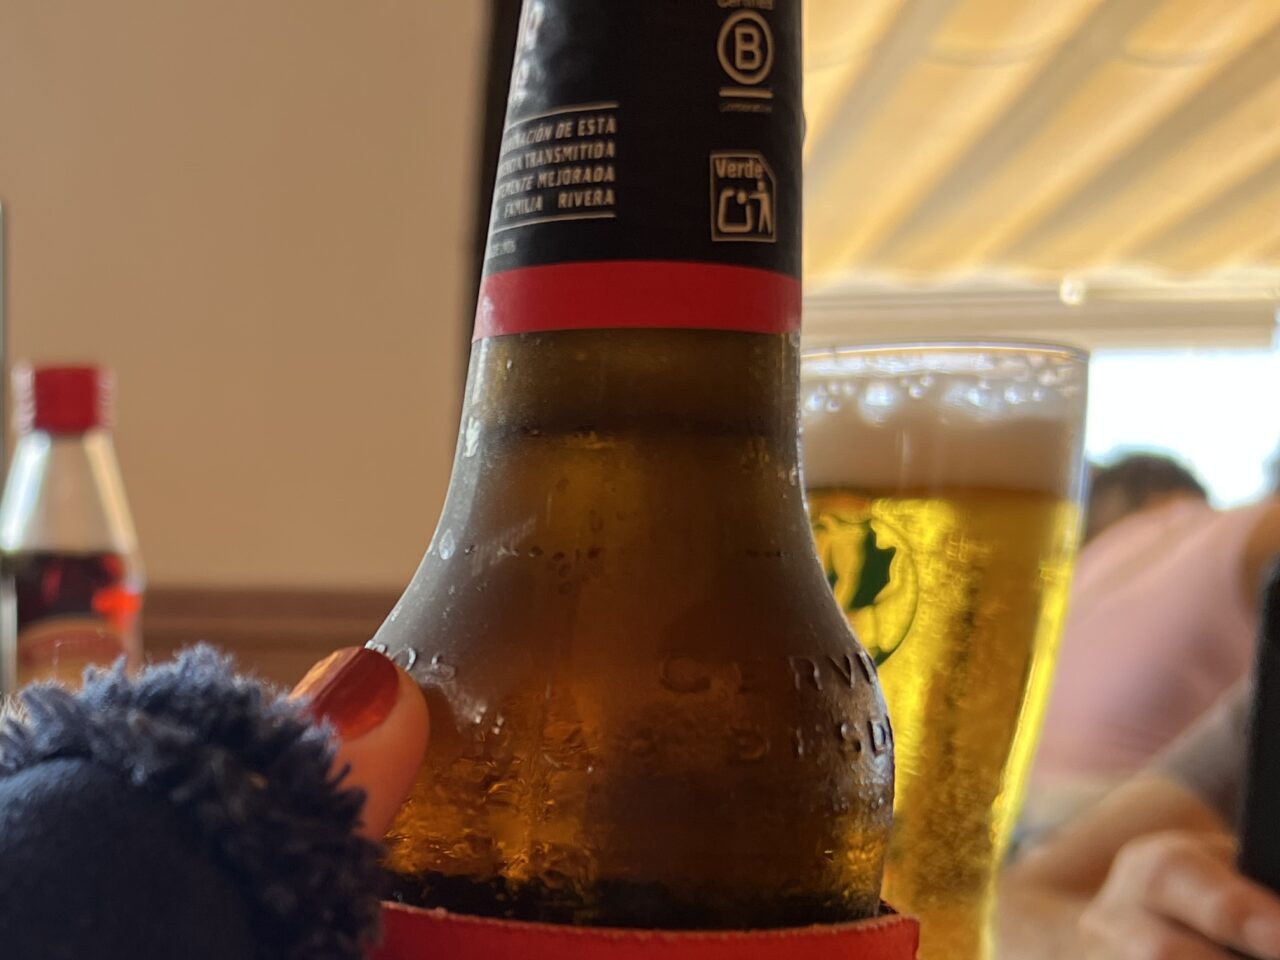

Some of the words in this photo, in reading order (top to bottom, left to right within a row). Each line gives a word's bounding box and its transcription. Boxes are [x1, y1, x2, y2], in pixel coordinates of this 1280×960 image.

[555, 120, 573, 139] DE
[577, 116, 617, 137] ESTA
[524, 141, 615, 170] TRANSMITIDA
[536, 165, 615, 190] MEJORADA
[715, 159, 763, 180] Verde
[504, 195, 544, 218] FAMILIA
[557, 189, 615, 209] RIVERA
